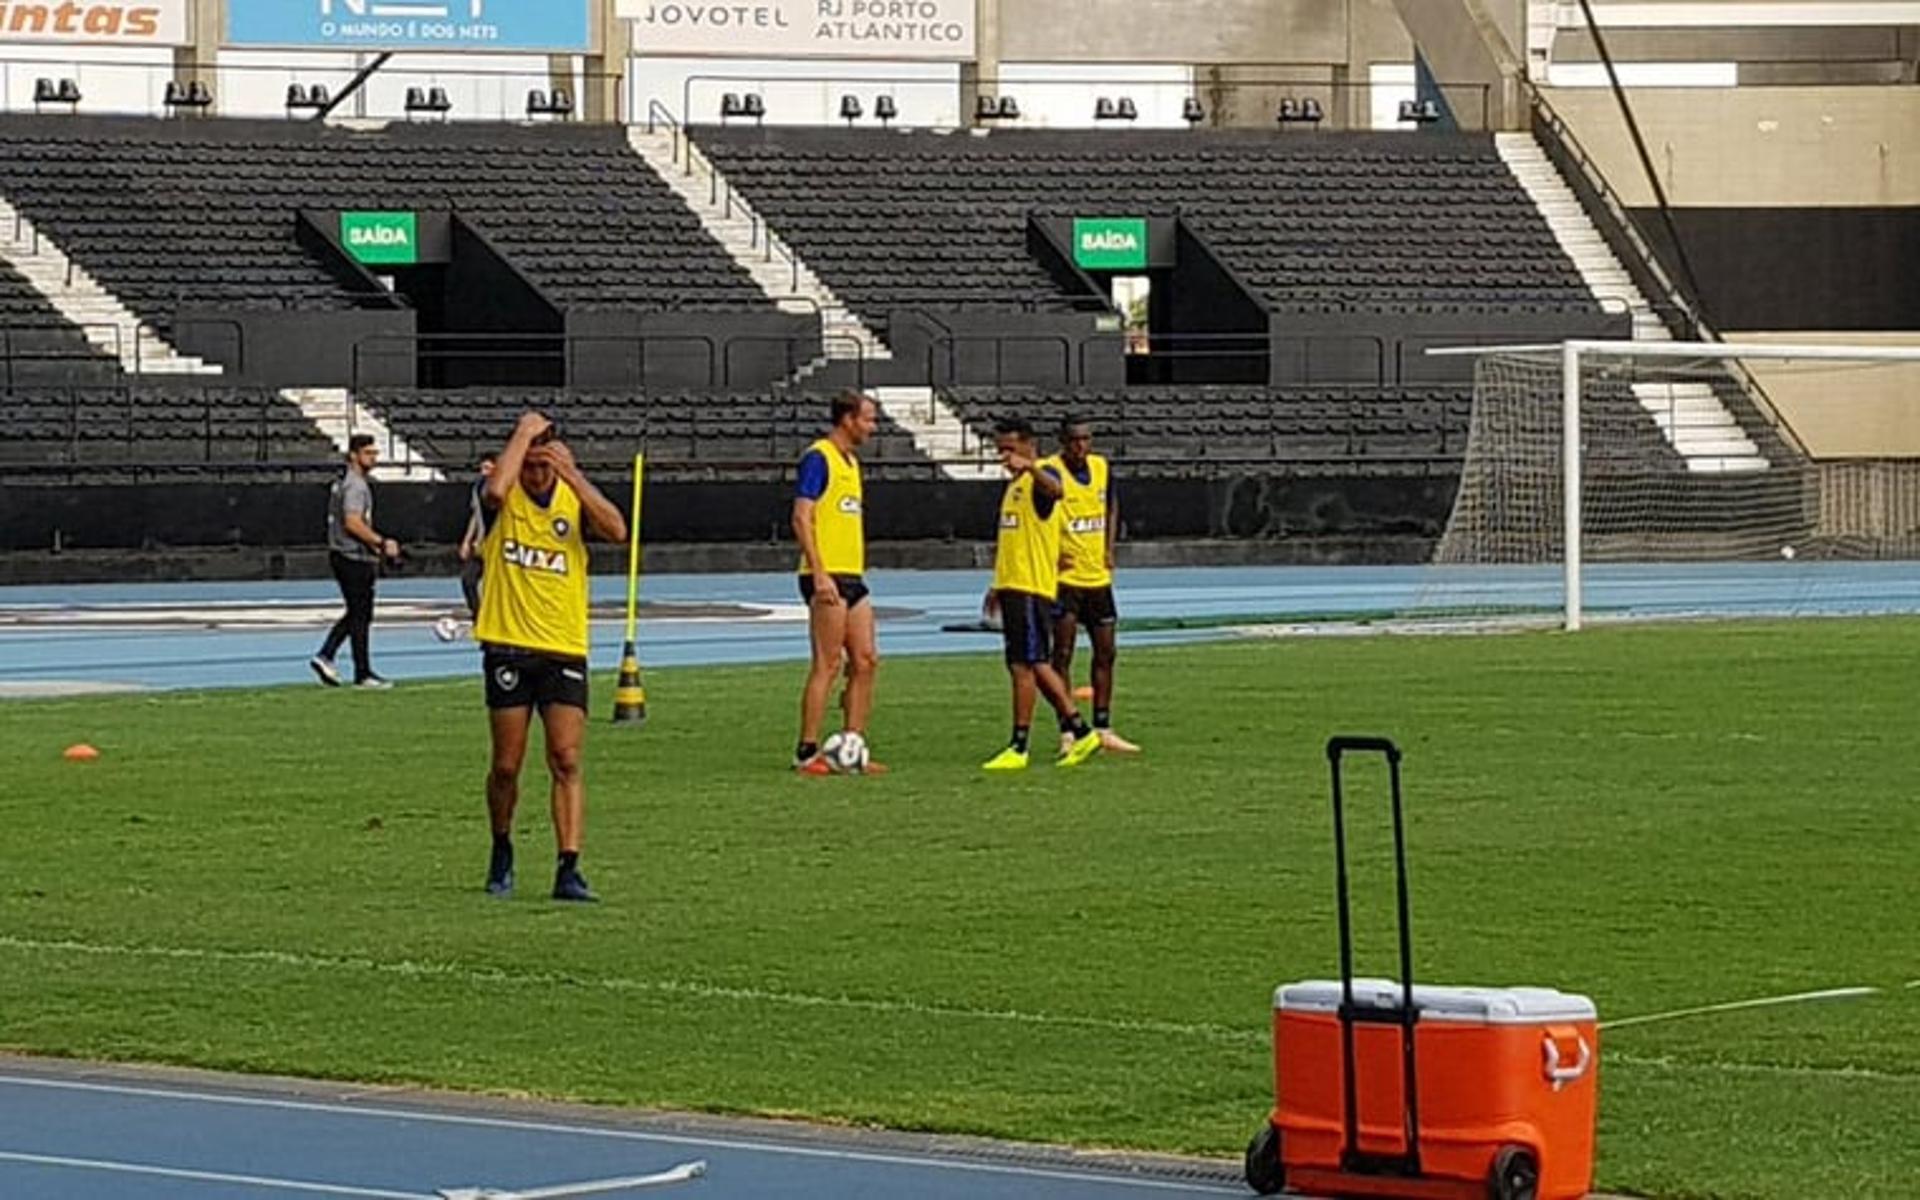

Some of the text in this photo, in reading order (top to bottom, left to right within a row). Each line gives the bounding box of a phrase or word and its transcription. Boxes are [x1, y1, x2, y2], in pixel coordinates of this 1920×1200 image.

[816, 0, 938, 18] RJ PORTO
[321, 22, 335, 36] O
[340, 23, 403, 38] MUNDO
[421, 24, 454, 39] DOS
[458, 26, 499, 39] NETS
[815, 22, 964, 41] ATLANTICO
[350, 223, 408, 245] SAÍDA
[1081, 229, 1138, 250] SAÍDA
